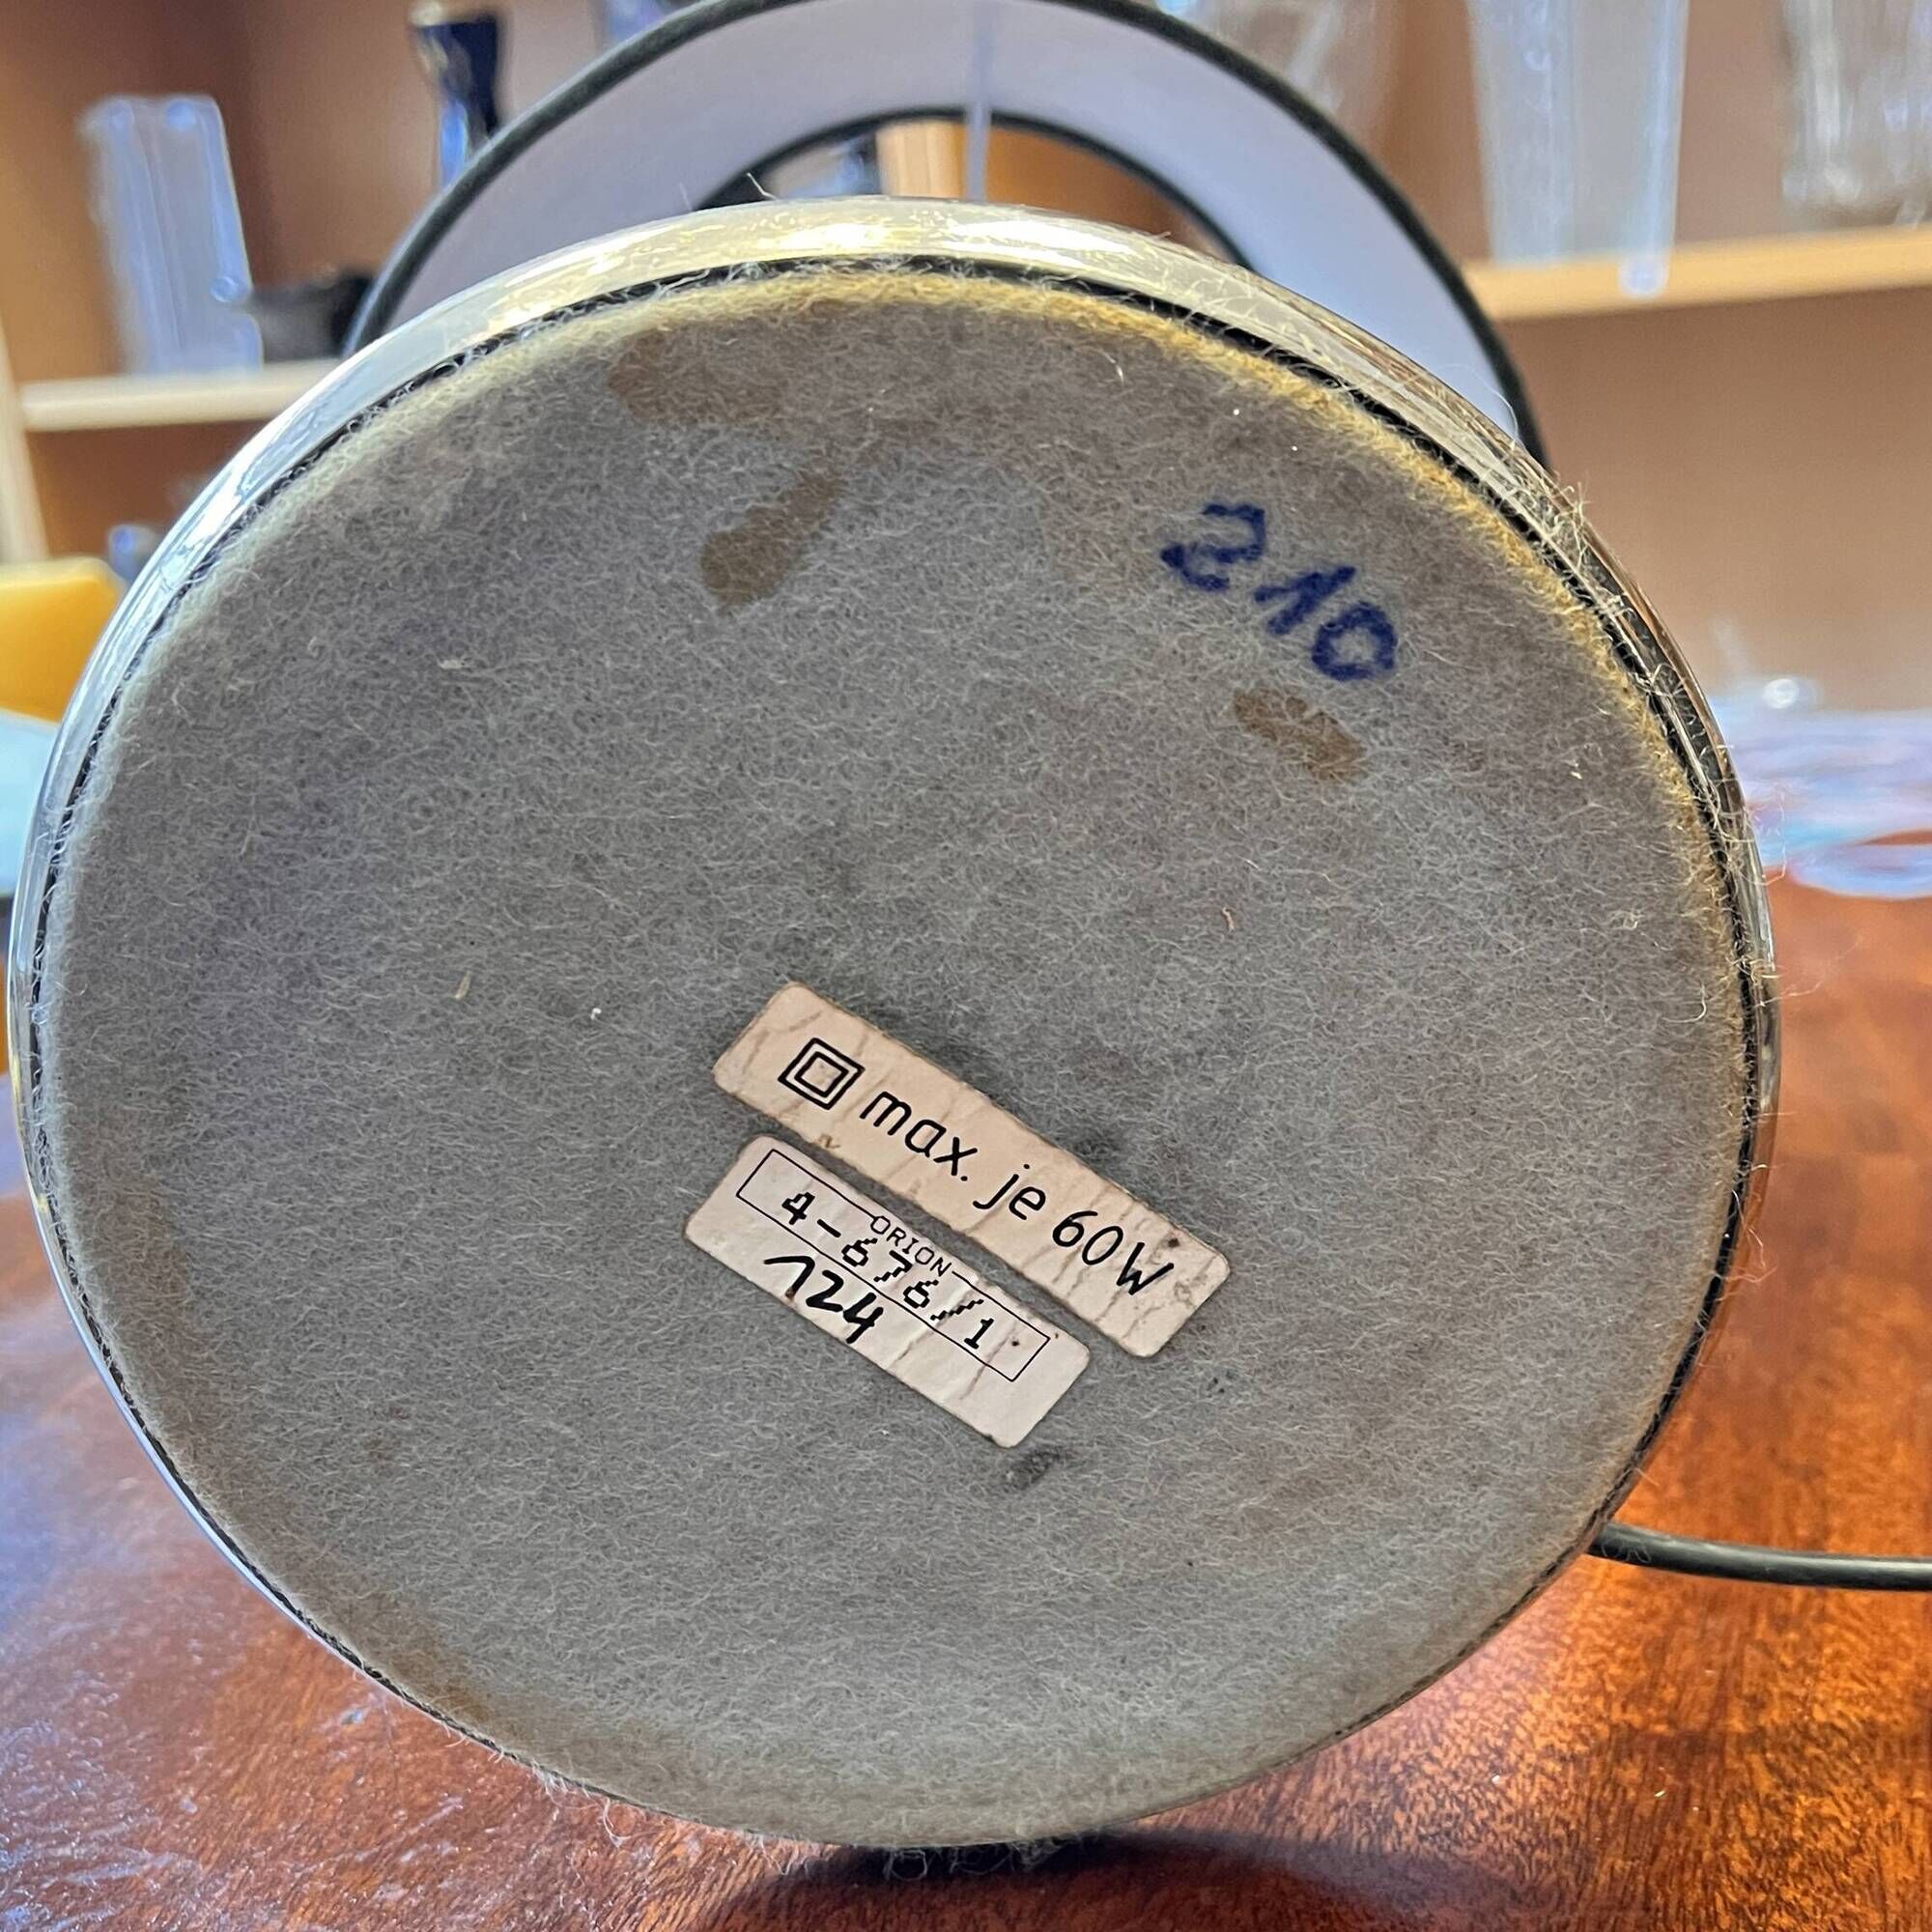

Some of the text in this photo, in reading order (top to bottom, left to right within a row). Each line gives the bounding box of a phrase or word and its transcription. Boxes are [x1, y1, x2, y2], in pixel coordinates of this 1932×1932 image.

[1160, 502, 1398, 681] 210
[781, 1192, 995, 1350] 4-676/1
[860, 1092, 1175, 1295] max. je 60W
[870, 1215, 953, 1275] ORION
[764, 1255, 884, 1343] 124
